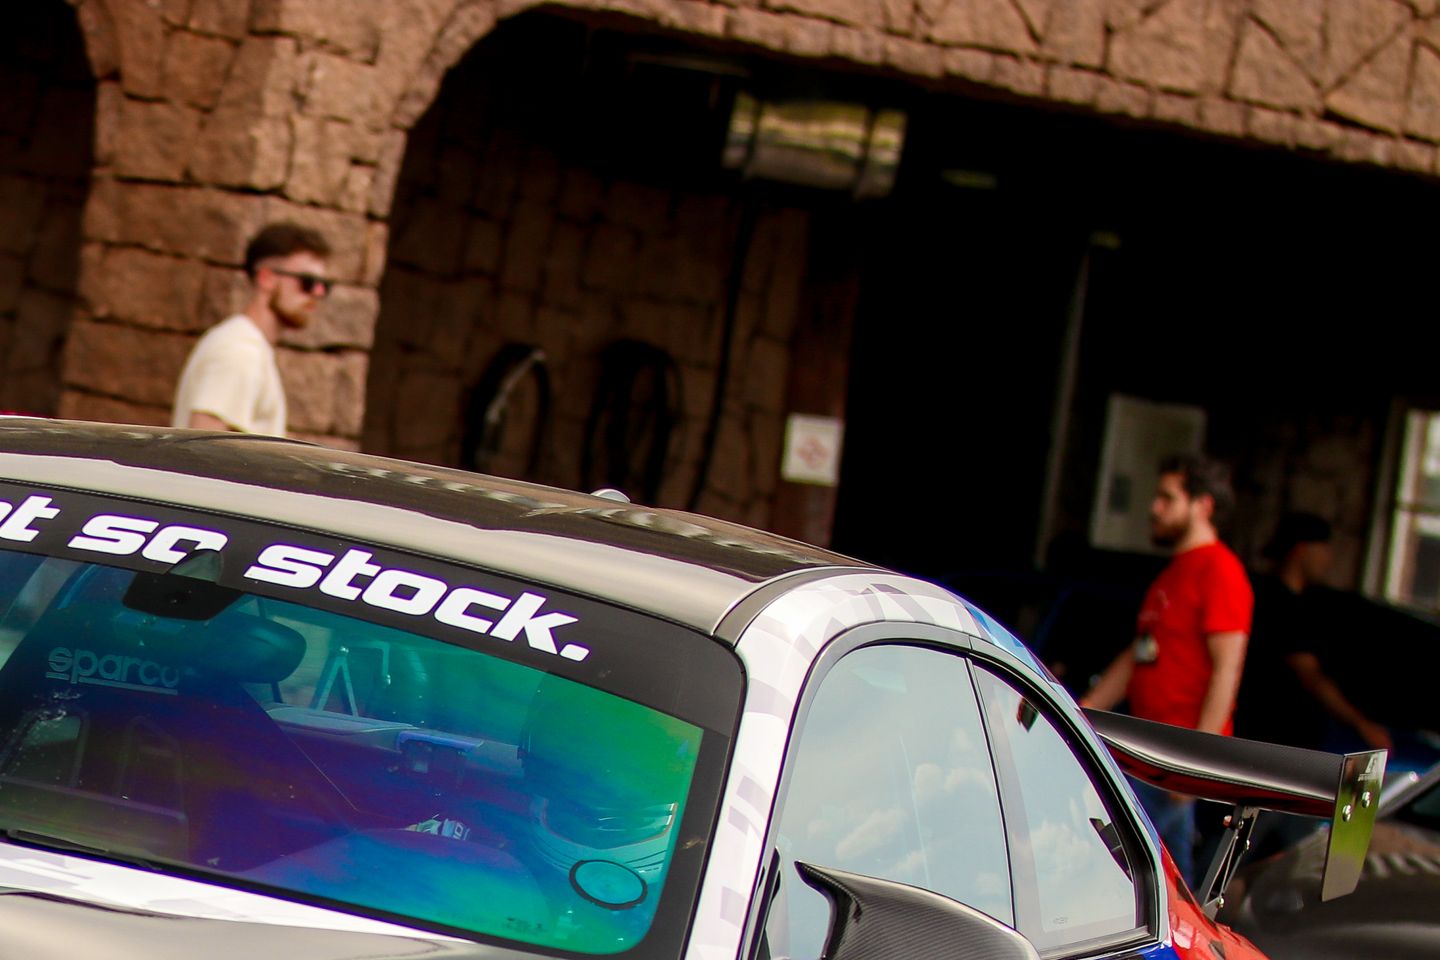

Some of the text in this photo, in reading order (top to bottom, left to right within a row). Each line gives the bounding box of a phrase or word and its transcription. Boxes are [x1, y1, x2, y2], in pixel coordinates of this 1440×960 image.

[68, 514, 228, 564] so
[243, 543, 590, 662] stock.
[47, 646, 181, 684] sparco
